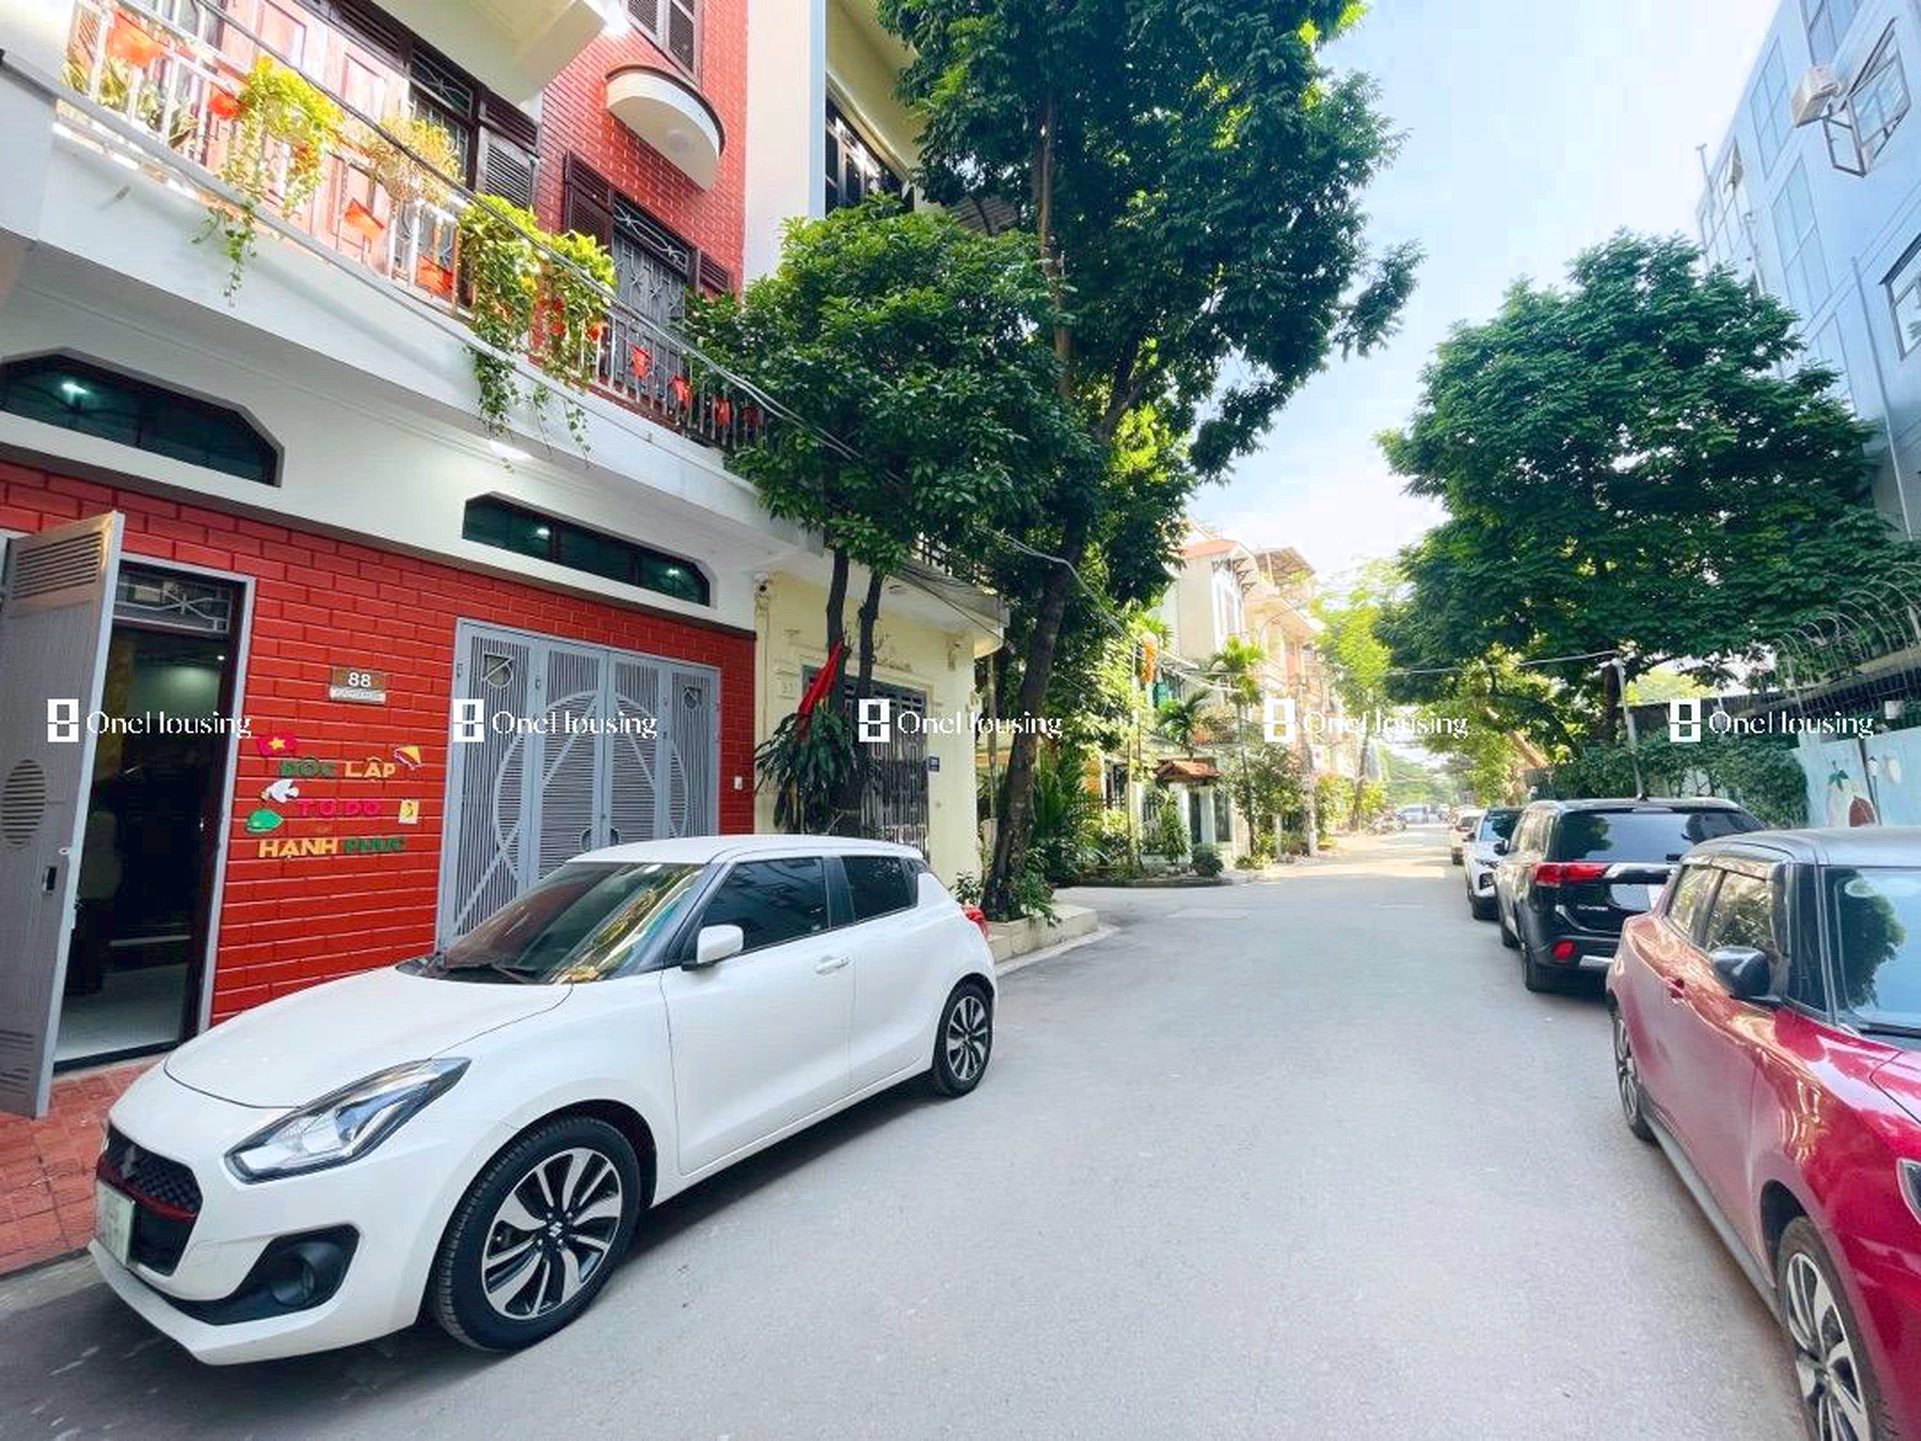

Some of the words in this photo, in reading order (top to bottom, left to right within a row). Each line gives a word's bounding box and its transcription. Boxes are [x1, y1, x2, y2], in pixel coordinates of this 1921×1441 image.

[348, 671, 371, 687] 88
[344, 755, 396, 783] LẬP
[258, 837, 338, 859] HẠNH
